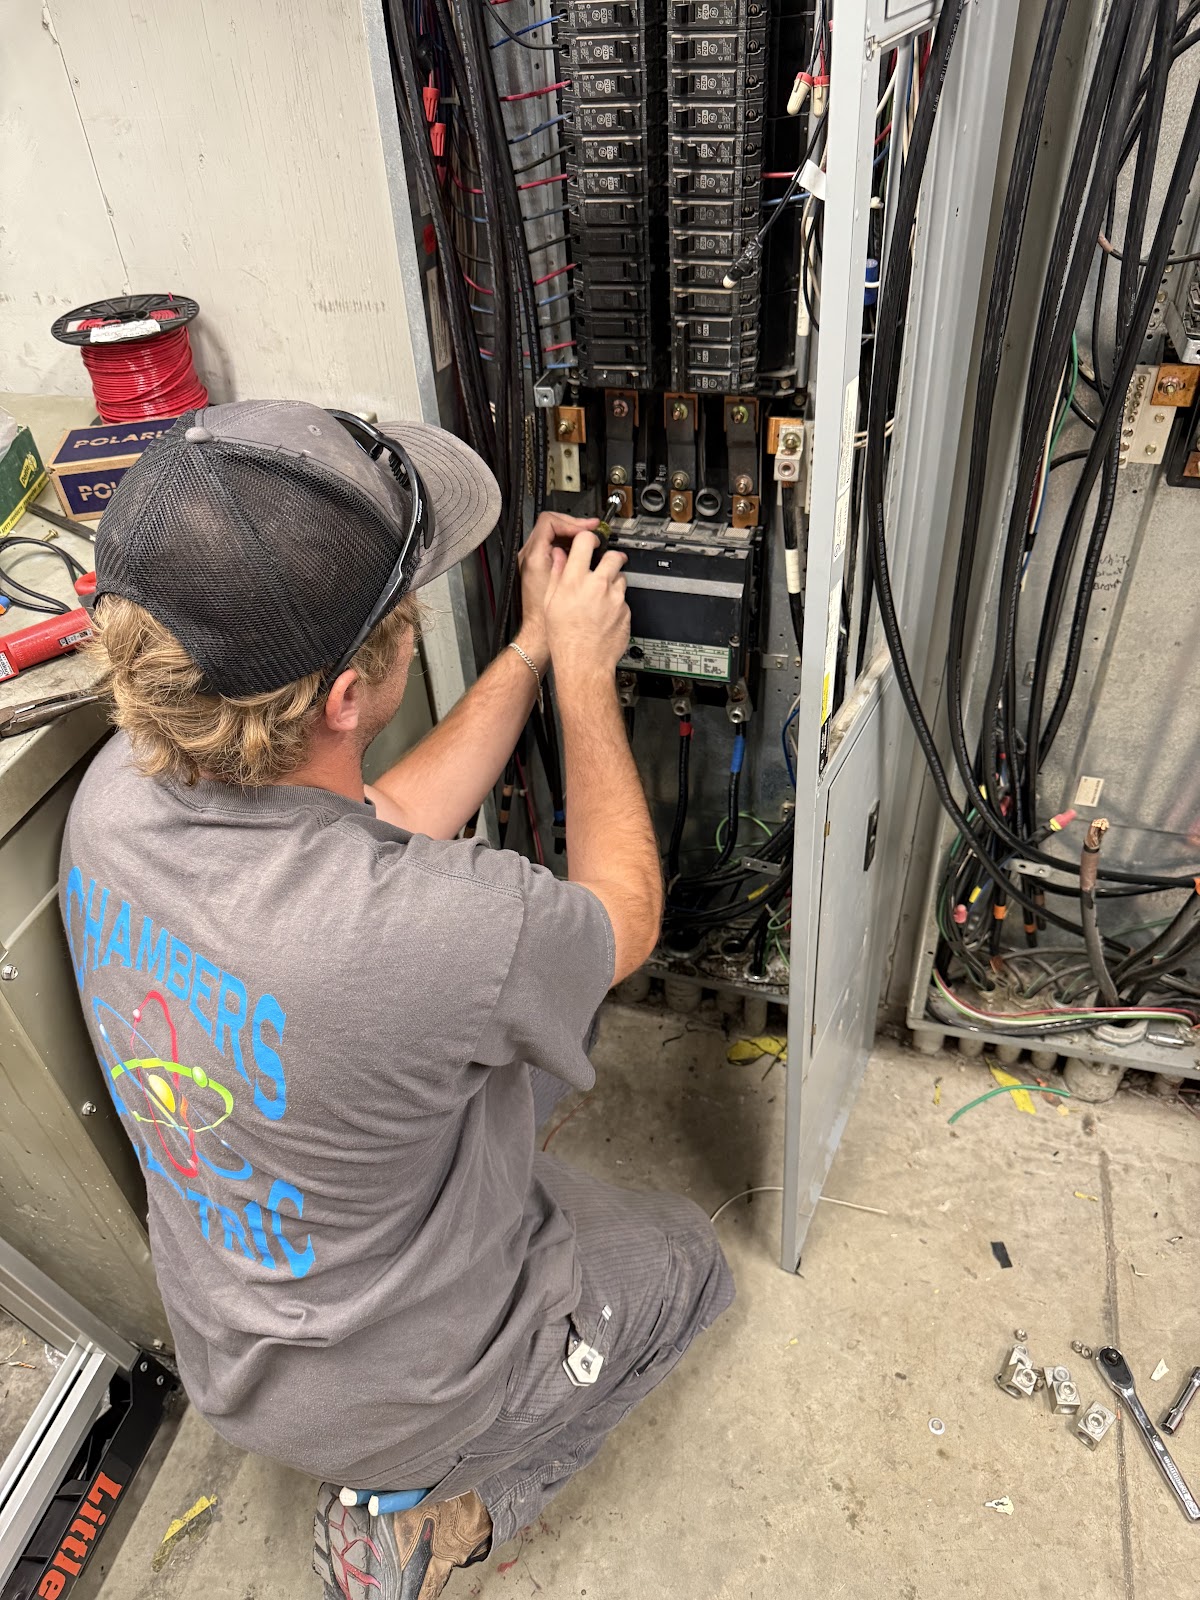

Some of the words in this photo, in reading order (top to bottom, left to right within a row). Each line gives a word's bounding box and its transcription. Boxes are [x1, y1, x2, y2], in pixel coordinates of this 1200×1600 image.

[658, 560, 670, 568] LINE
[66, 866, 287, 1120] CHAMBERS
[38, 1471, 122, 1600] Little
